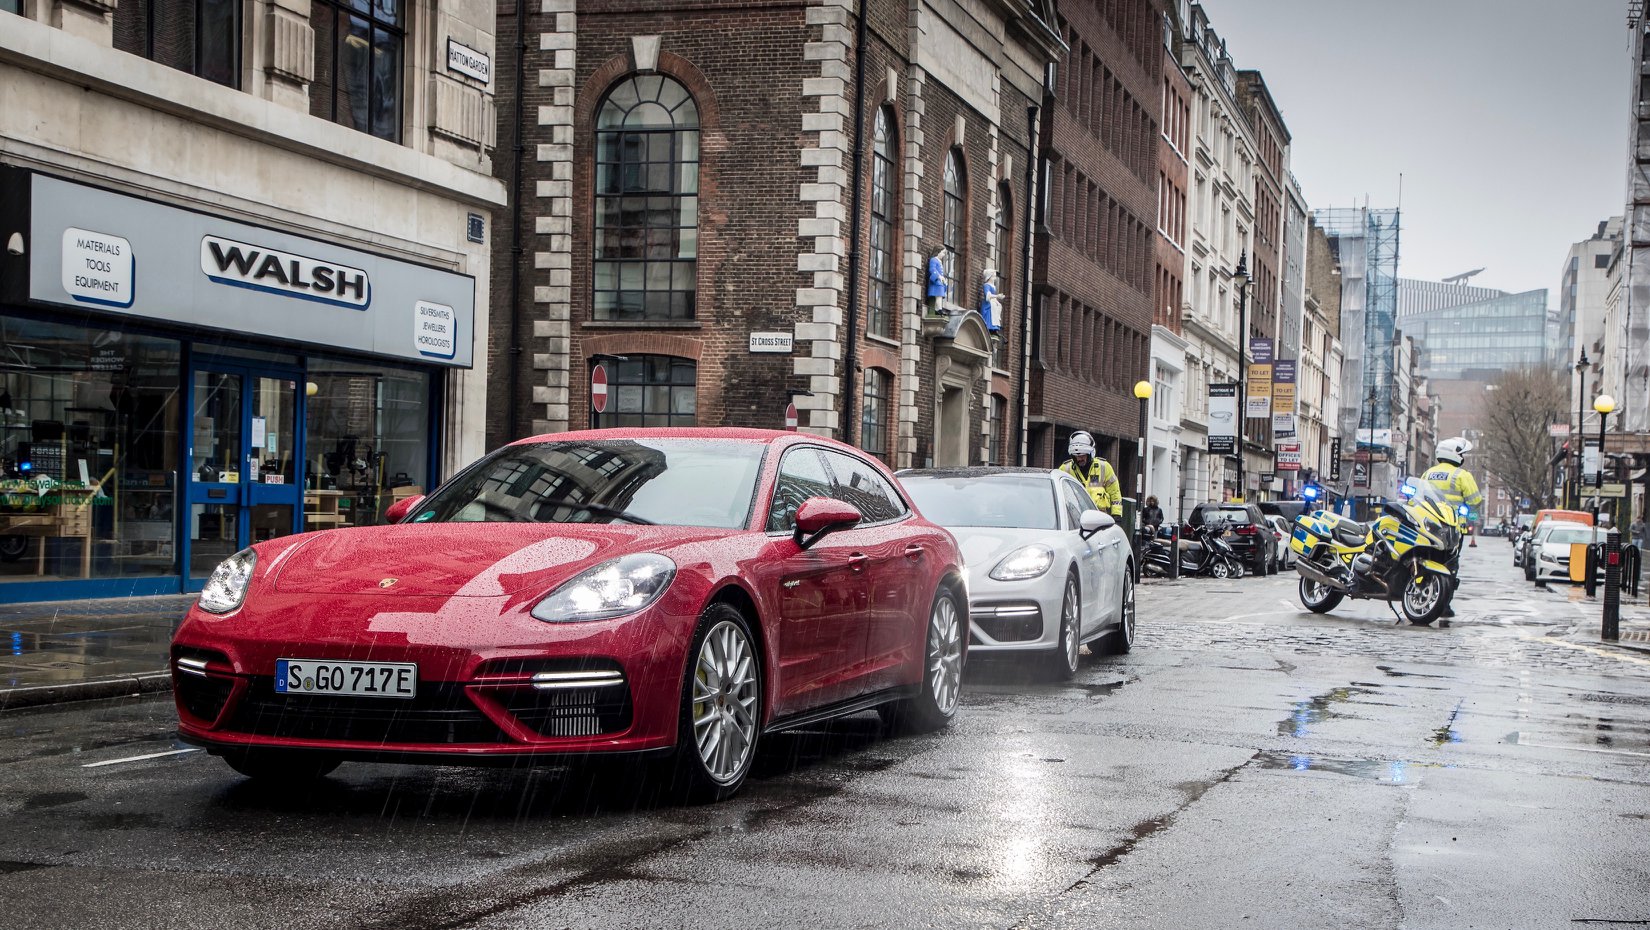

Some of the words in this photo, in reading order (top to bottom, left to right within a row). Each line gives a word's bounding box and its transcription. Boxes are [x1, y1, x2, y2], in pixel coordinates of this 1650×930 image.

[450, 48, 469, 67] HATTON
[469, 56, 488, 75] GARDEN
[76, 238, 120, 256] MATERIALS
[85, 258, 111, 273] TOOLS
[208, 241, 364, 299] WALSH
[75, 275, 119, 292] EQUIPMENT
[420, 306, 450, 320] SILVERSMITHS
[423, 321, 446, 334] JEWELLERS
[417, 335, 450, 348] HOROLOGISTS
[758, 337, 774, 346] CROSS
[774, 337, 791, 346] STREET
[279, 679, 285, 687] D
[288, 664, 302, 689] S
[315, 665, 345, 691] GO
[350, 667, 411, 693] 717E
